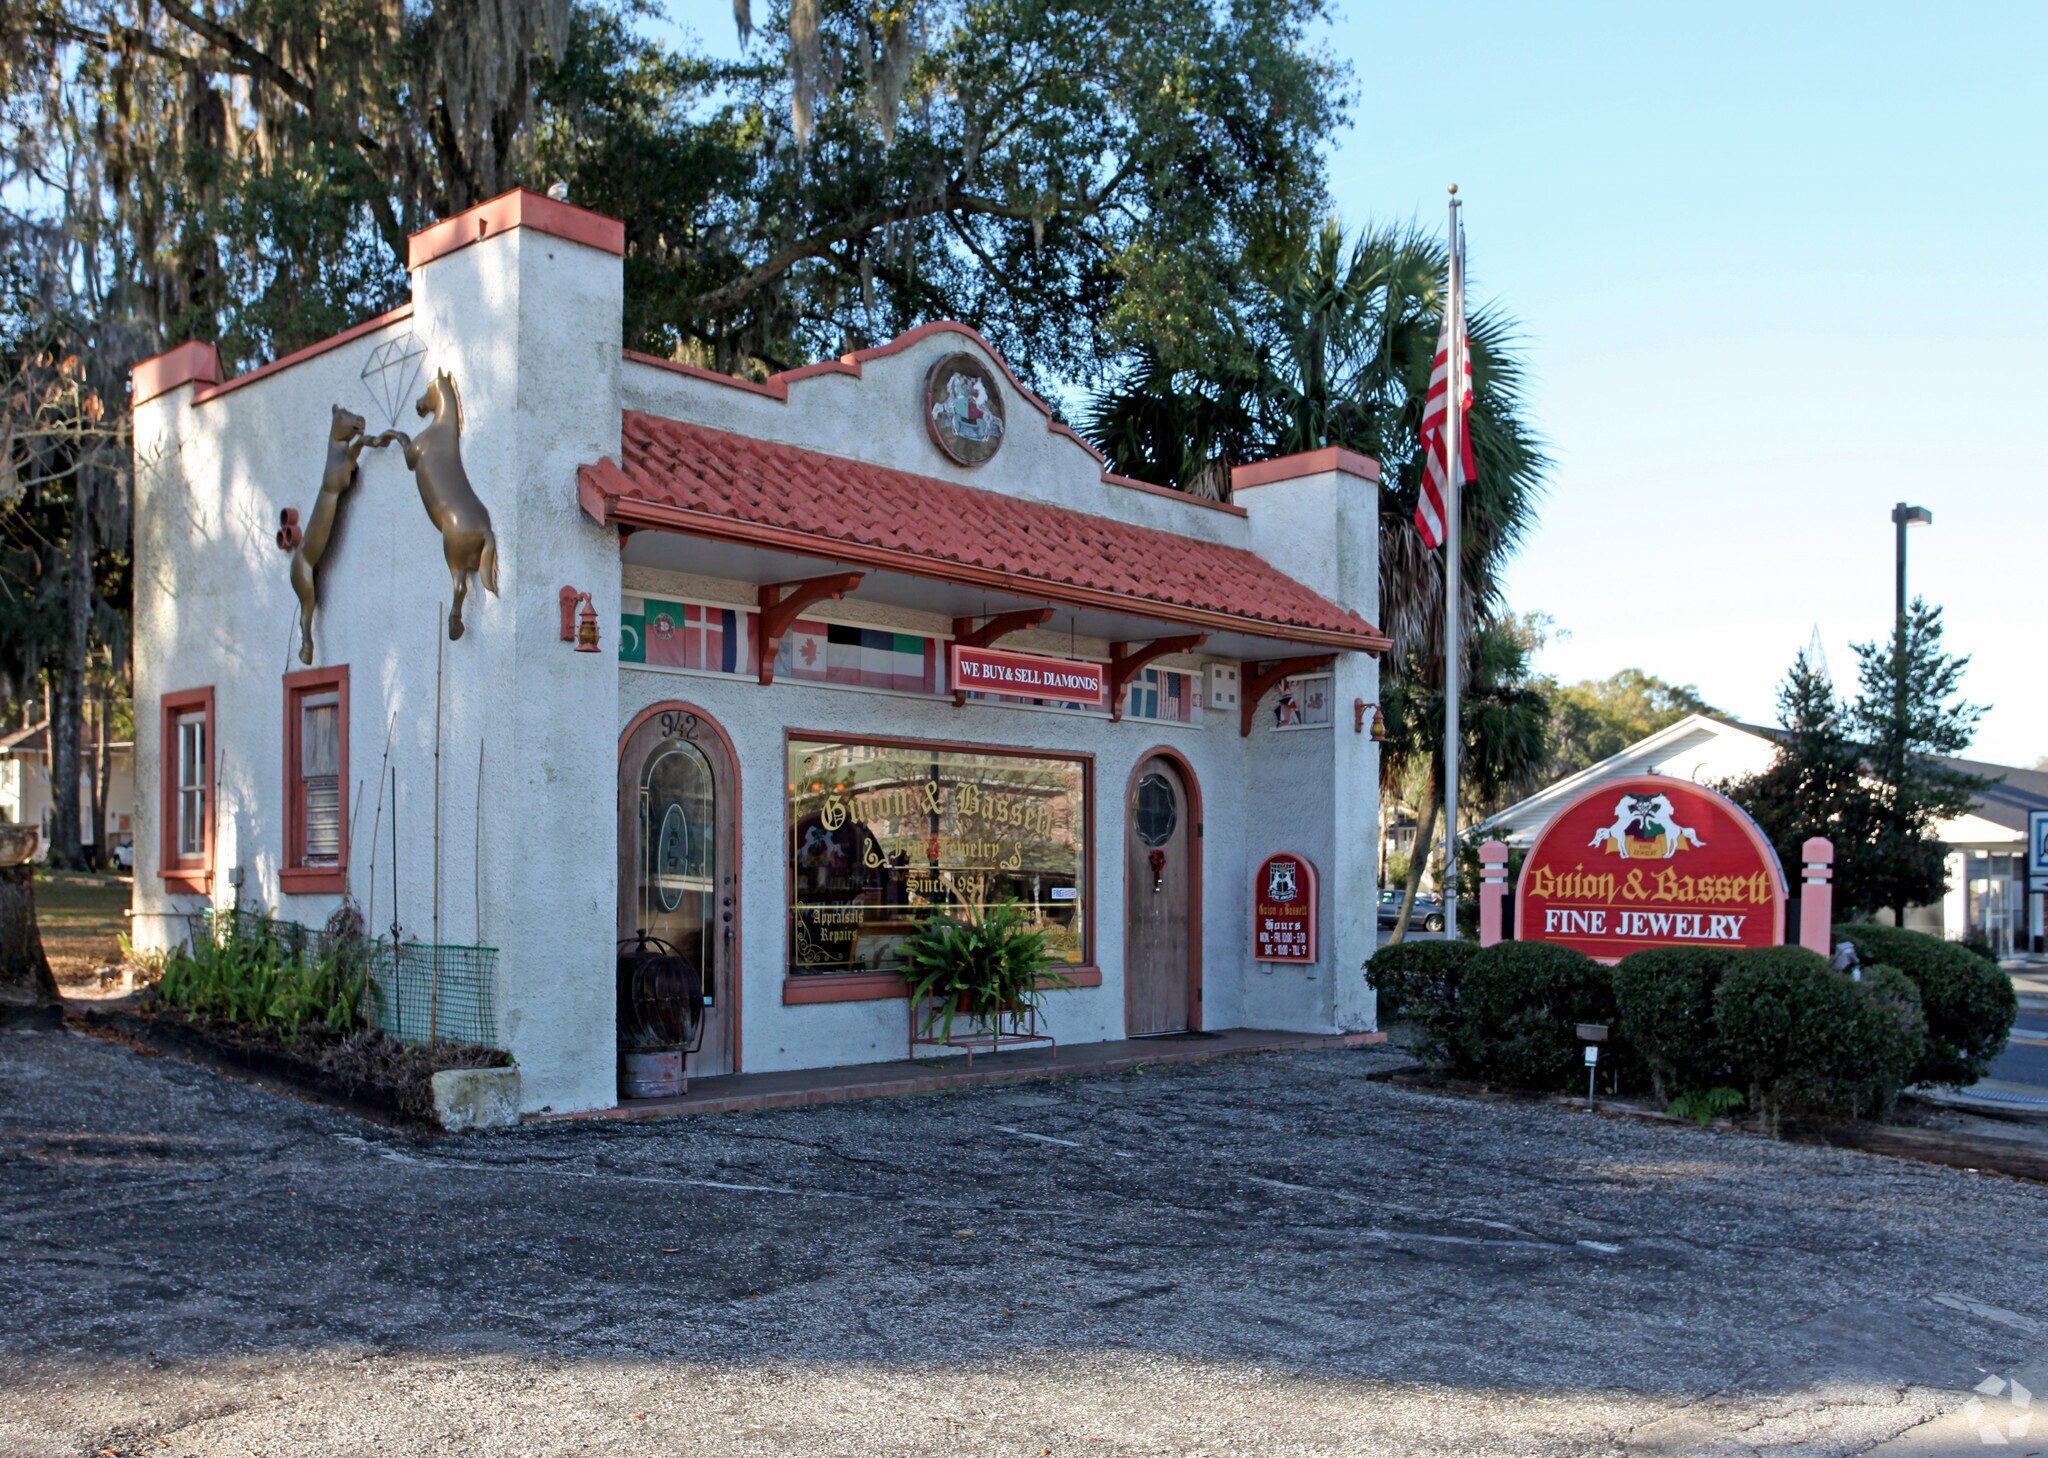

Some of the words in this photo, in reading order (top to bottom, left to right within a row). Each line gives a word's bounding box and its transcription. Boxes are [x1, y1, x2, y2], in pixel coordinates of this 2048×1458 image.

[961, 661, 980, 678] WE
[1014, 668, 1042, 685] SELL
[1043, 671, 1098, 692] DIAMONDS
[661, 713, 699, 738] 942
[920, 780, 945, 815] &
[955, 782, 1055, 839] Bassett
[906, 874, 945, 894] Since
[1529, 863, 1620, 904] Guion
[1622, 868, 1652, 902] &
[1651, 866, 1773, 904] Bassett
[812, 909, 865, 926] Appraisals
[1265, 918, 1301, 932] Hours
[1545, 909, 1607, 935] FINE
[1615, 911, 1747, 940] JEWELRY
[819, 927, 858, 944] Repairs
